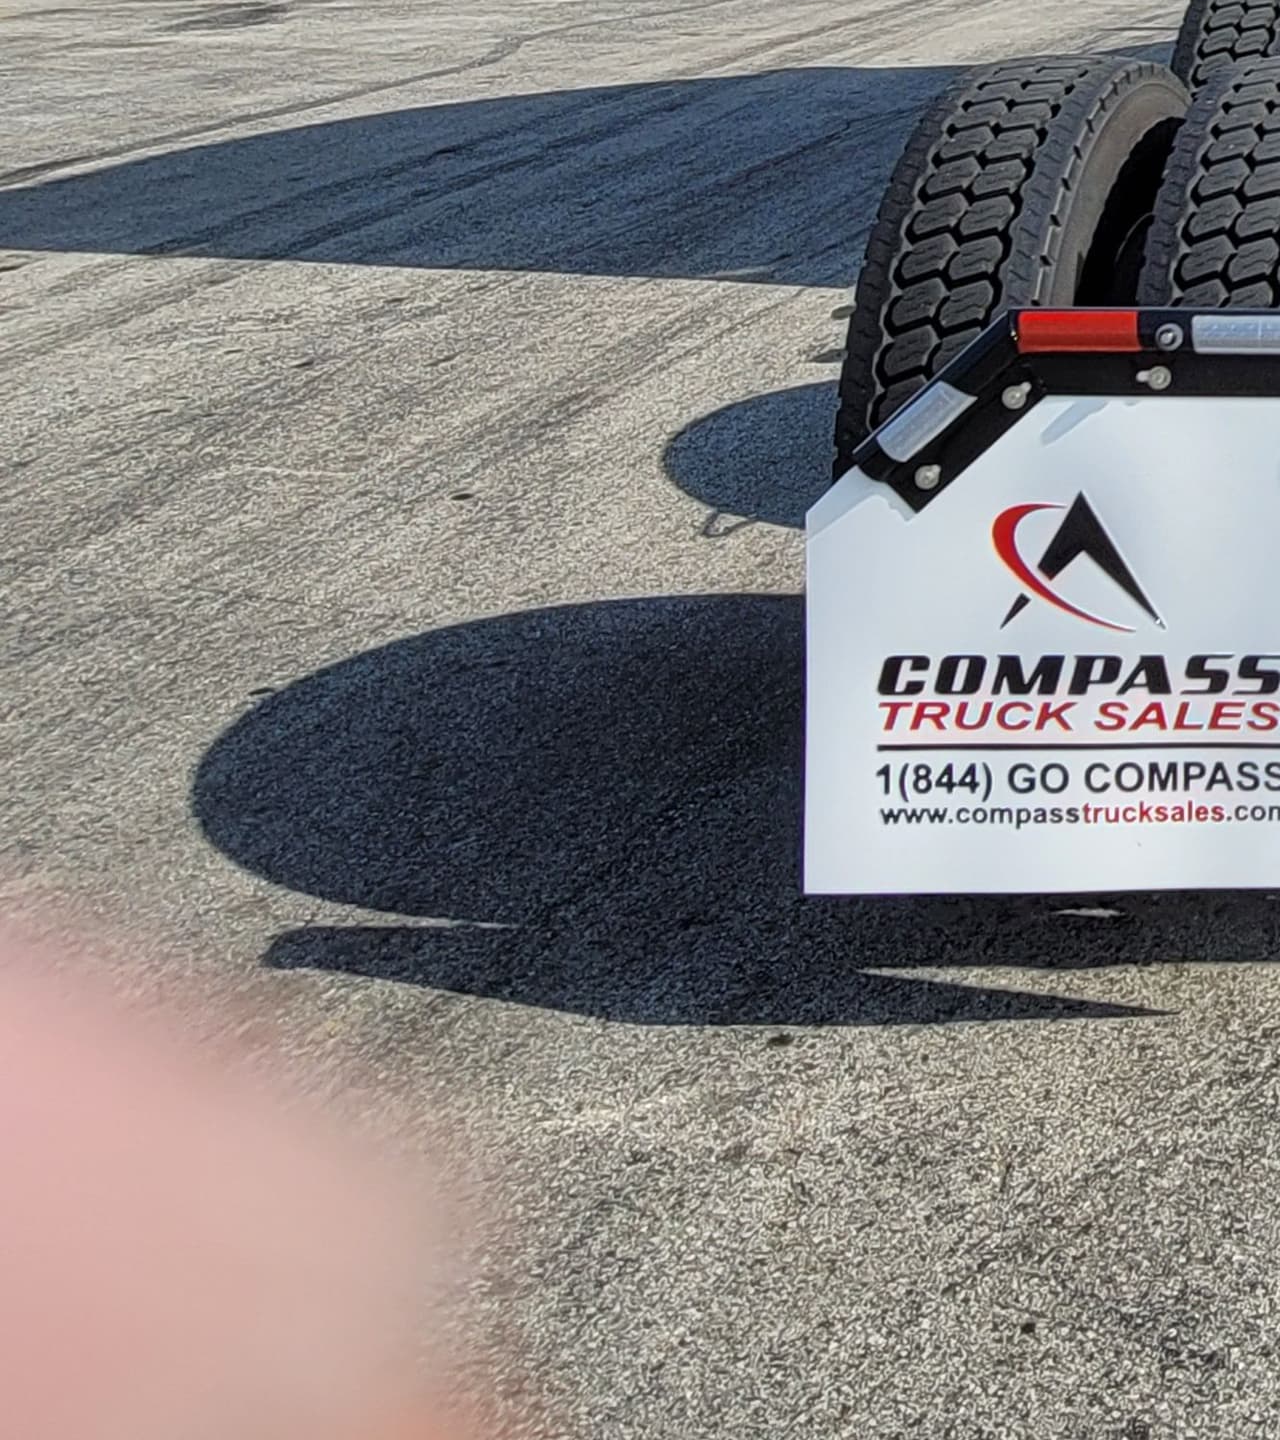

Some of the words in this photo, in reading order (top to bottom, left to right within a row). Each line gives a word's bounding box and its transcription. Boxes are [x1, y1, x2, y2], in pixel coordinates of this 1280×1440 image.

[878, 701, 1078, 731] TRUCK
[876, 762, 993, 802] 1(844)
[1007, 763, 1070, 794] GO
